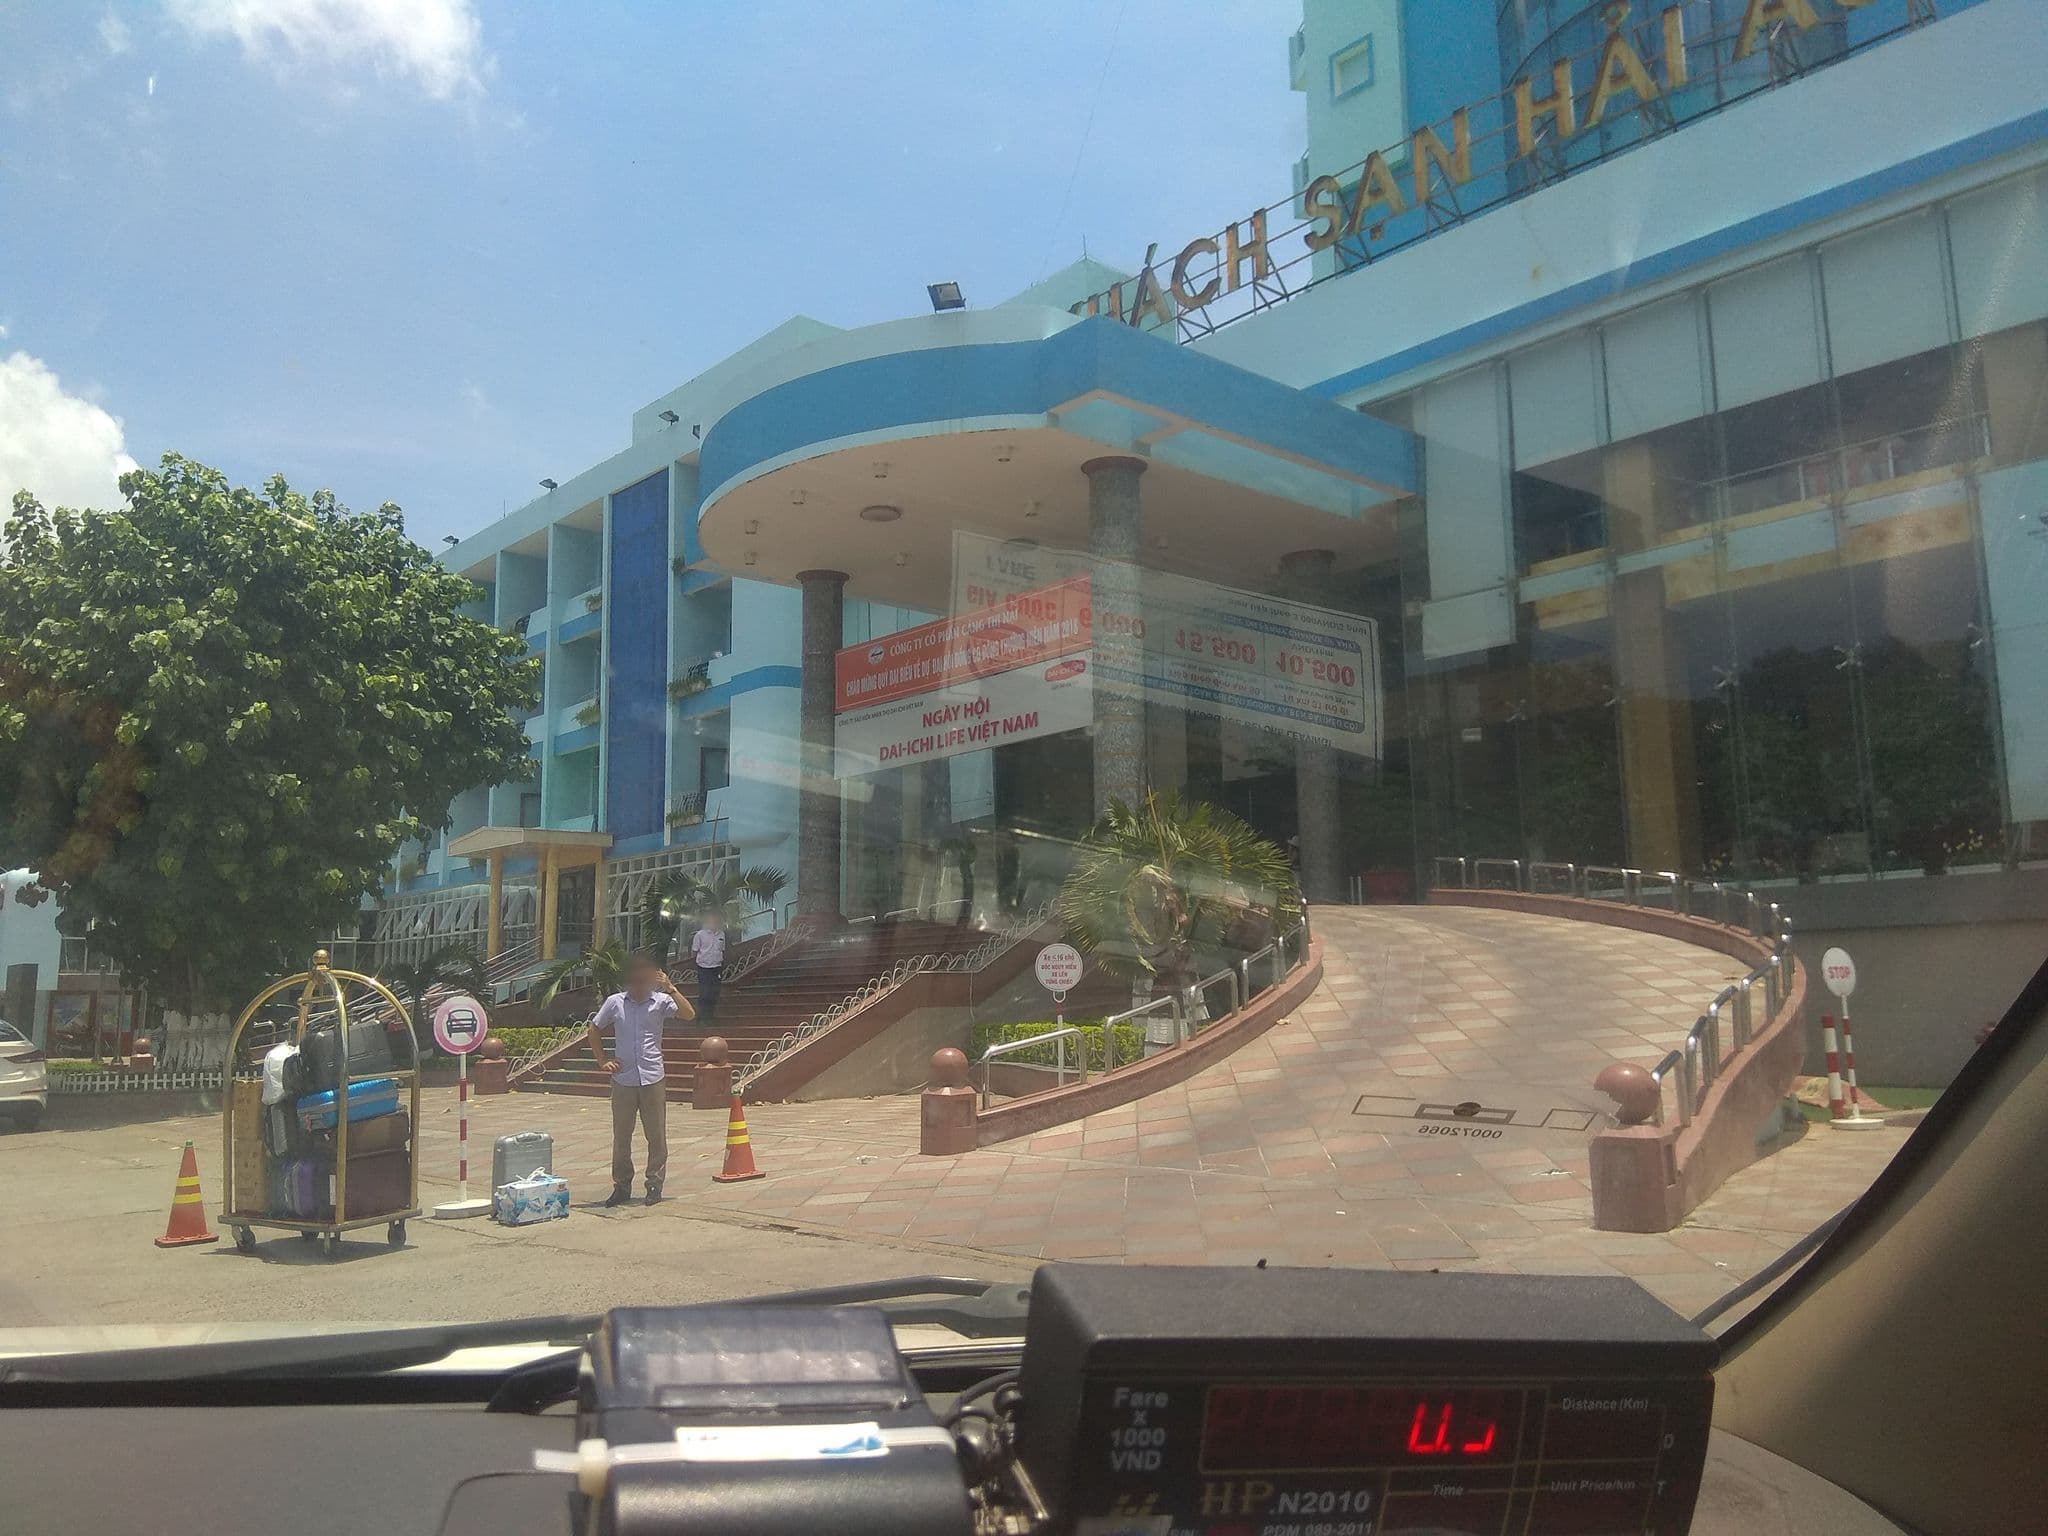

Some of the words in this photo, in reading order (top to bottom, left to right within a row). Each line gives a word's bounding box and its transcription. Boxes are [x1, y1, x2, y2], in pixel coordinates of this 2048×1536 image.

[1303, 107, 1471, 252] SẠN
[1515, 0, 1688, 157] HẢI
[914, 637, 923, 649] TY
[923, 704, 960, 728] NGÀY
[964, 695, 990, 719] HỘI
[879, 735, 934, 762] DAI-ICHI
[937, 728, 965, 749] LIFE
[968, 719, 999, 744] VIỆT
[1002, 711, 1039, 735] NAM
[1828, 966, 1850, 979] STOP
[1113, 1387, 1169, 1409] Fare
[1562, 1396, 1618, 1411] Distance
[1619, 1396, 1649, 1411] (Km)
[1110, 1428, 1167, 1448] 1000
[1663, 1433, 1675, 1449] D
[1110, 1450, 1162, 1472] VND
[1432, 1483, 1464, 1497] Time
[1551, 1480, 1577, 1492] Unit
[1201, 1479, 1275, 1516] HP
